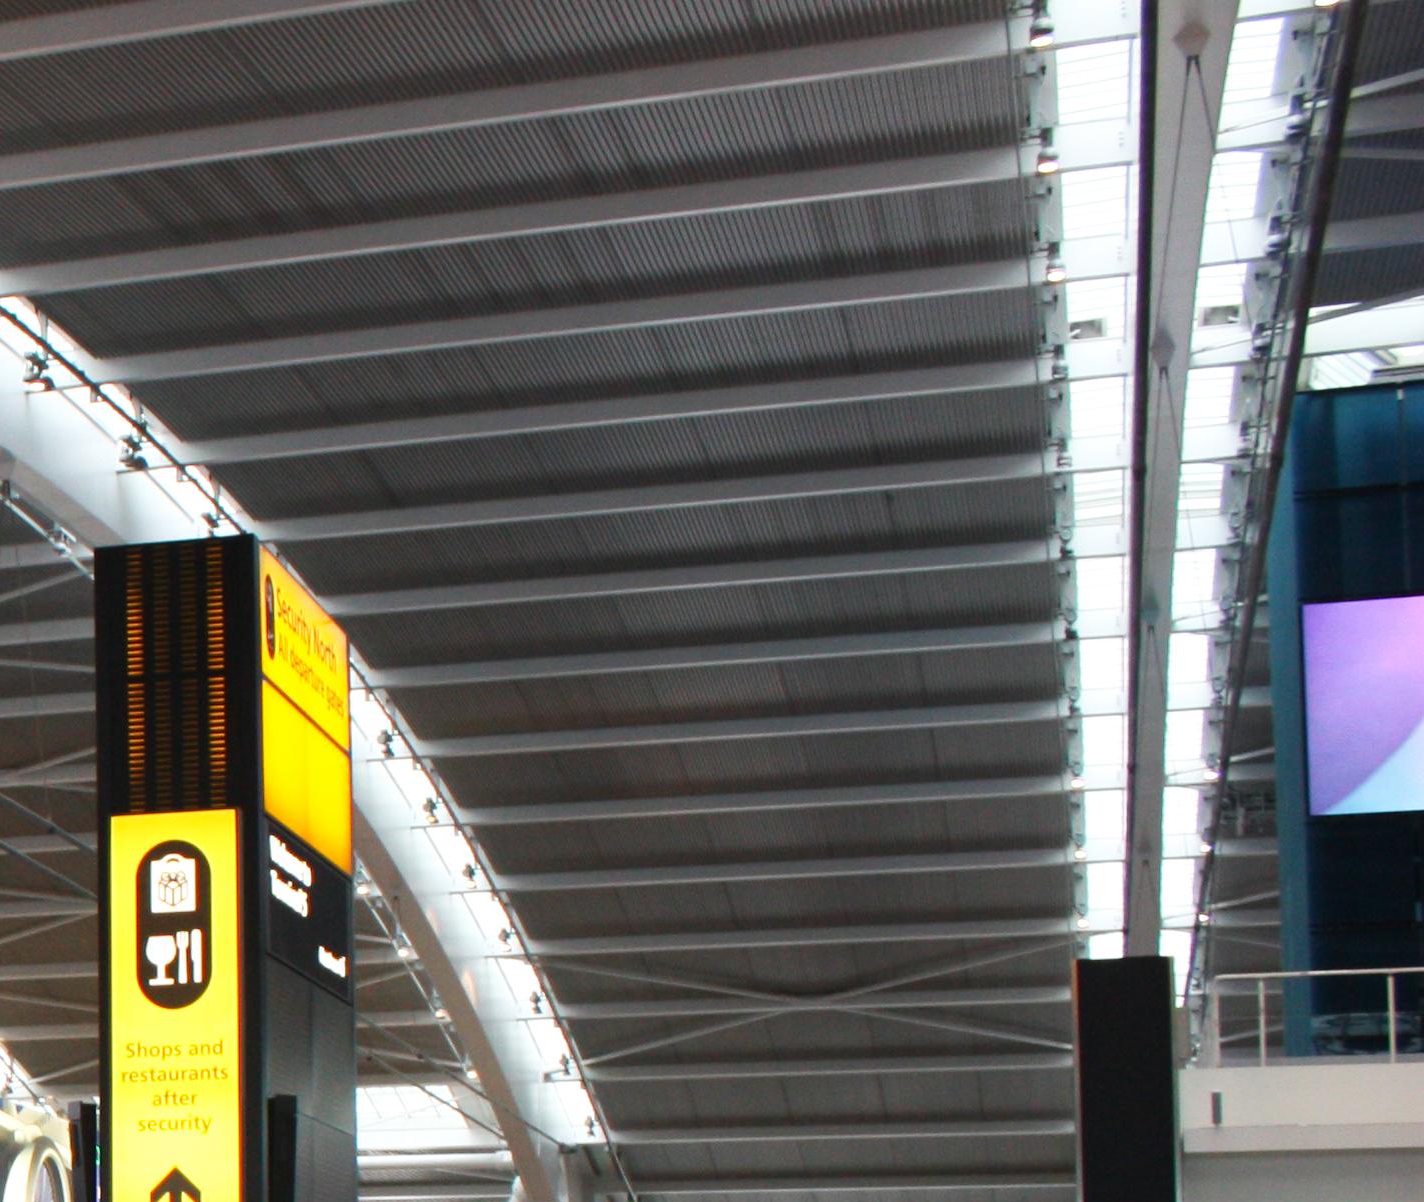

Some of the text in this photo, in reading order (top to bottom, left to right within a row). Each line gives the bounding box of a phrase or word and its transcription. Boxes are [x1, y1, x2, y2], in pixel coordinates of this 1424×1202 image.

[276, 587, 337, 675] Security North
[125, 1038, 224, 1060] Shops and
[120, 1065, 229, 1083] restaurants
[152, 1089, 198, 1107] after
[137, 1114, 213, 1135] security
